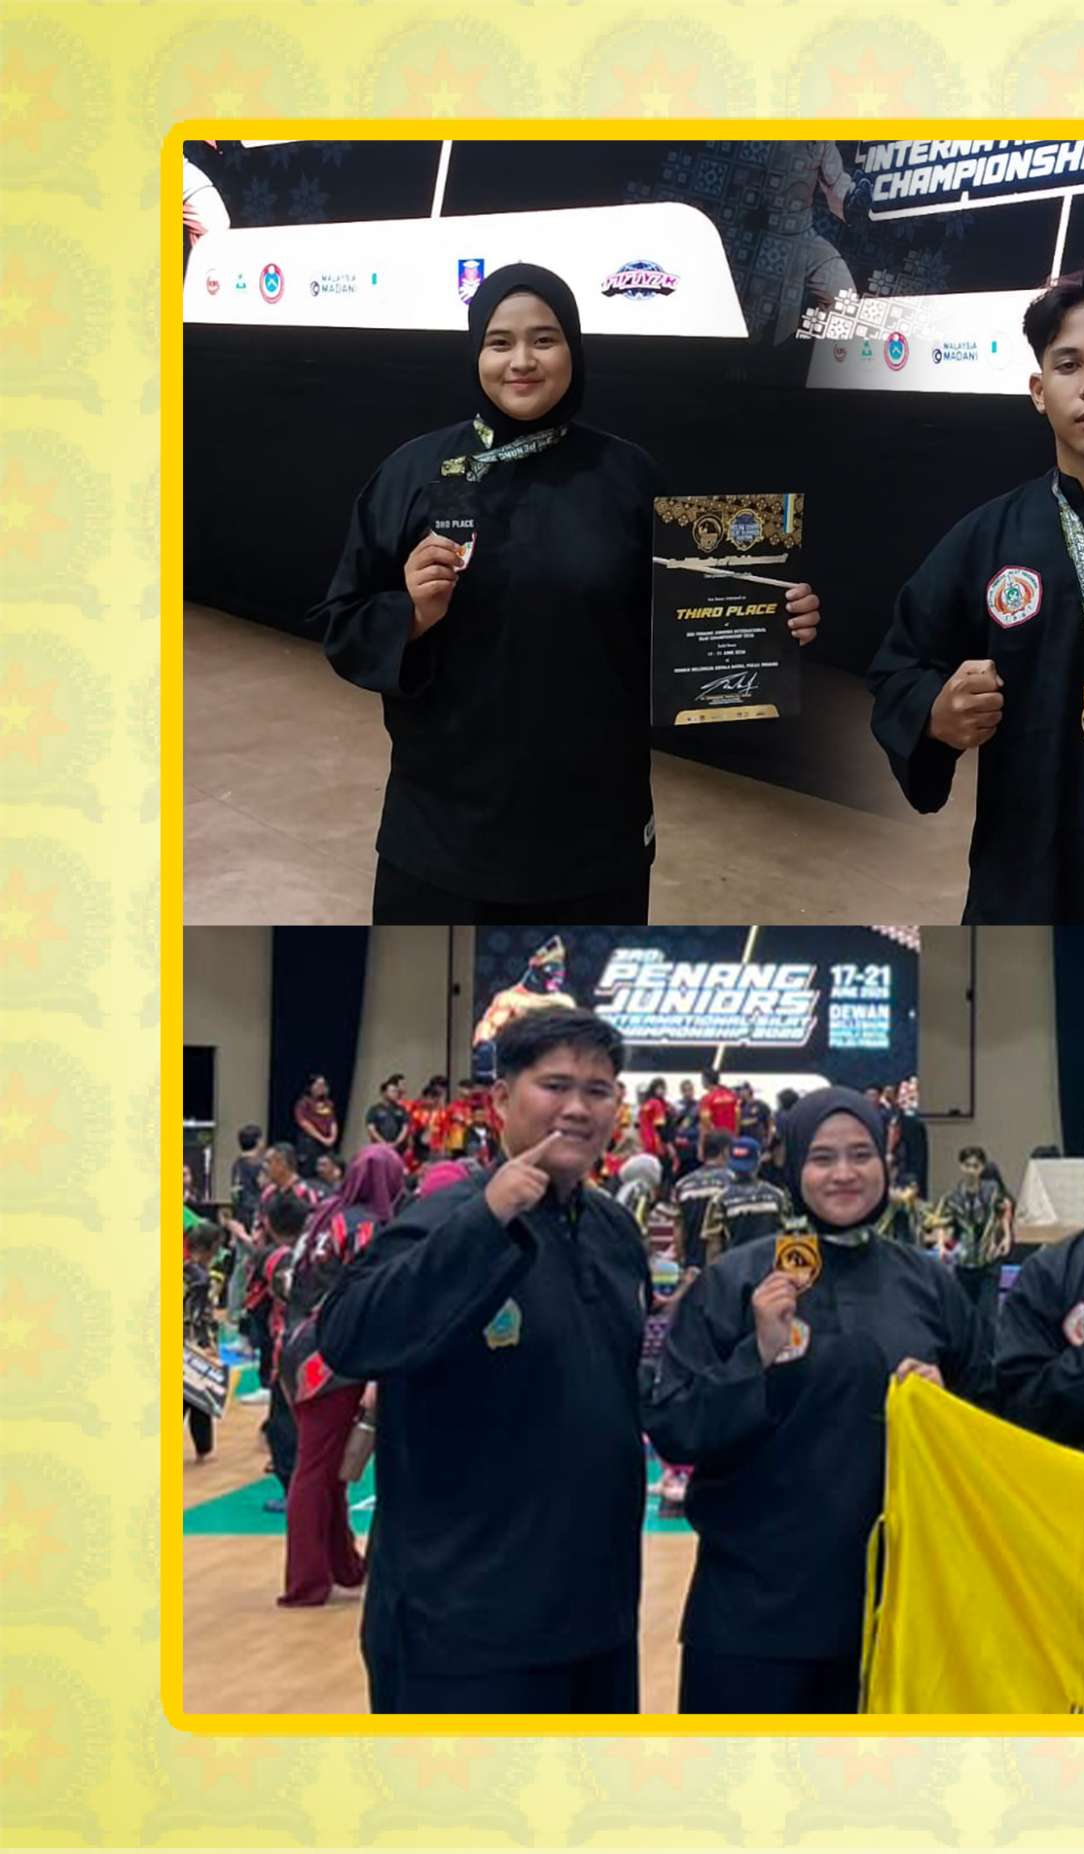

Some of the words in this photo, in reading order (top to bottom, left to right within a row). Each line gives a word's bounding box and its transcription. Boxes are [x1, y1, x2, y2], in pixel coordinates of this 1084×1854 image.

[943, 351, 978, 361] MADANI
[451, 519, 475, 529] PLACE
[676, 606, 724, 620] THIRD
[726, 603, 778, 617] PLACE
[600, 962, 812, 988] PENANG
[830, 964, 891, 986] 17-21
[594, 988, 816, 1014] JUNIORS
[829, 1004, 890, 1019] DEWAN
